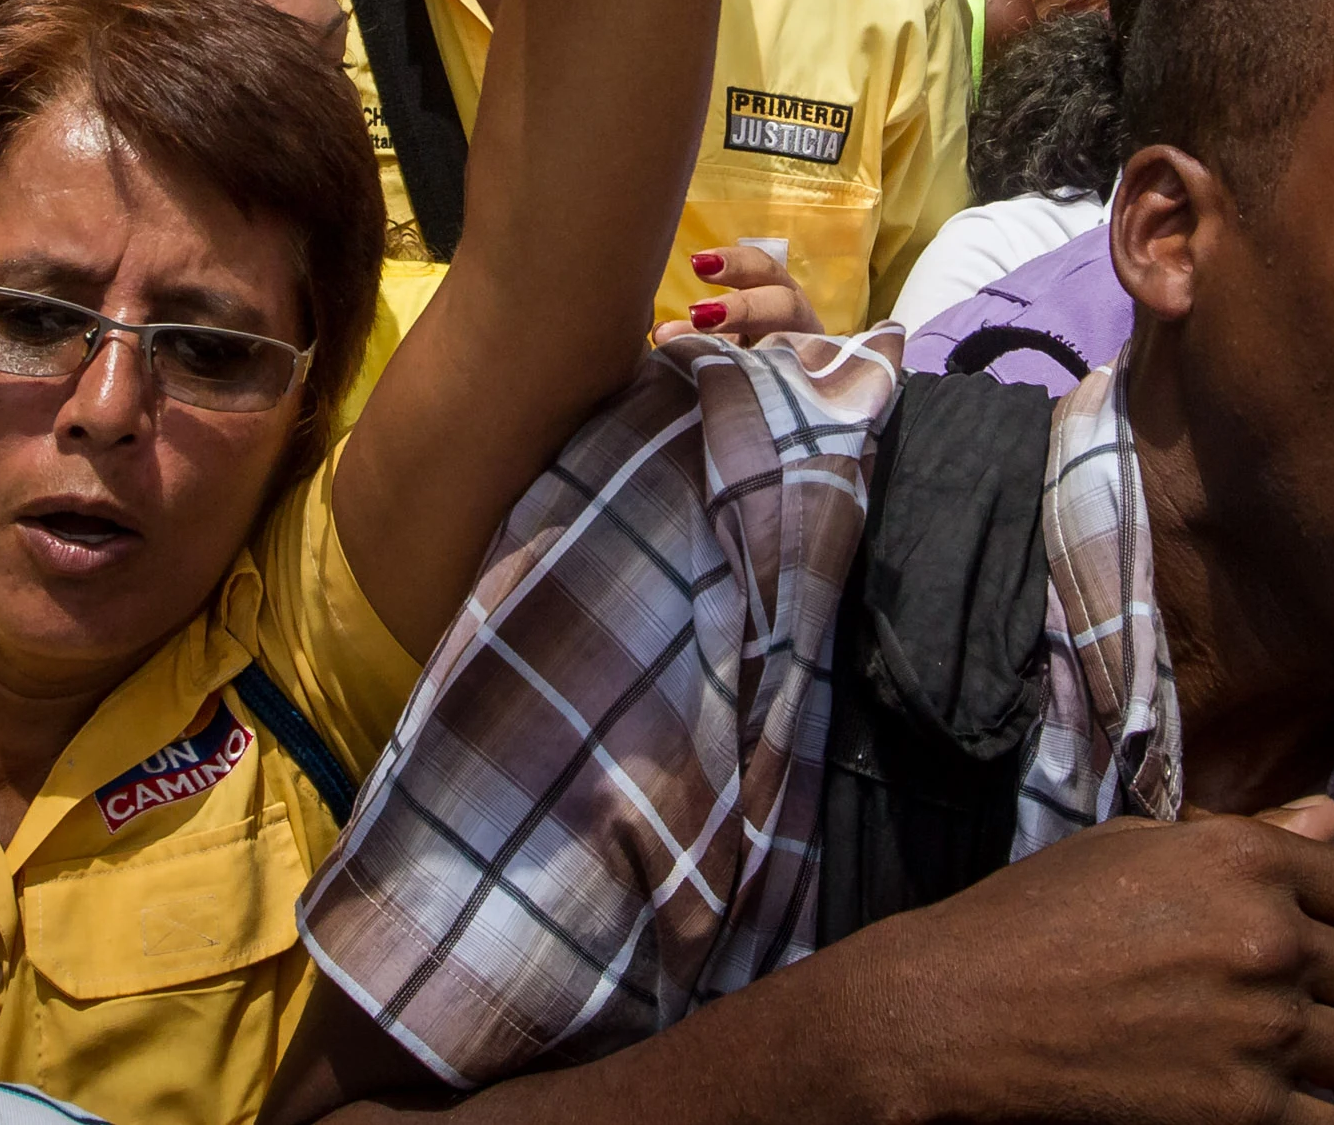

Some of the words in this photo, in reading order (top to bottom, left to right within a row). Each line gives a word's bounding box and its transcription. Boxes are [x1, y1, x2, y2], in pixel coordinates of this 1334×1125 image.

[733, 92, 845, 129] PRIMERO
[731, 117, 840, 160] JUSTICIA
[105, 727, 247, 821] CAMINO
[140, 739, 201, 774] UN
